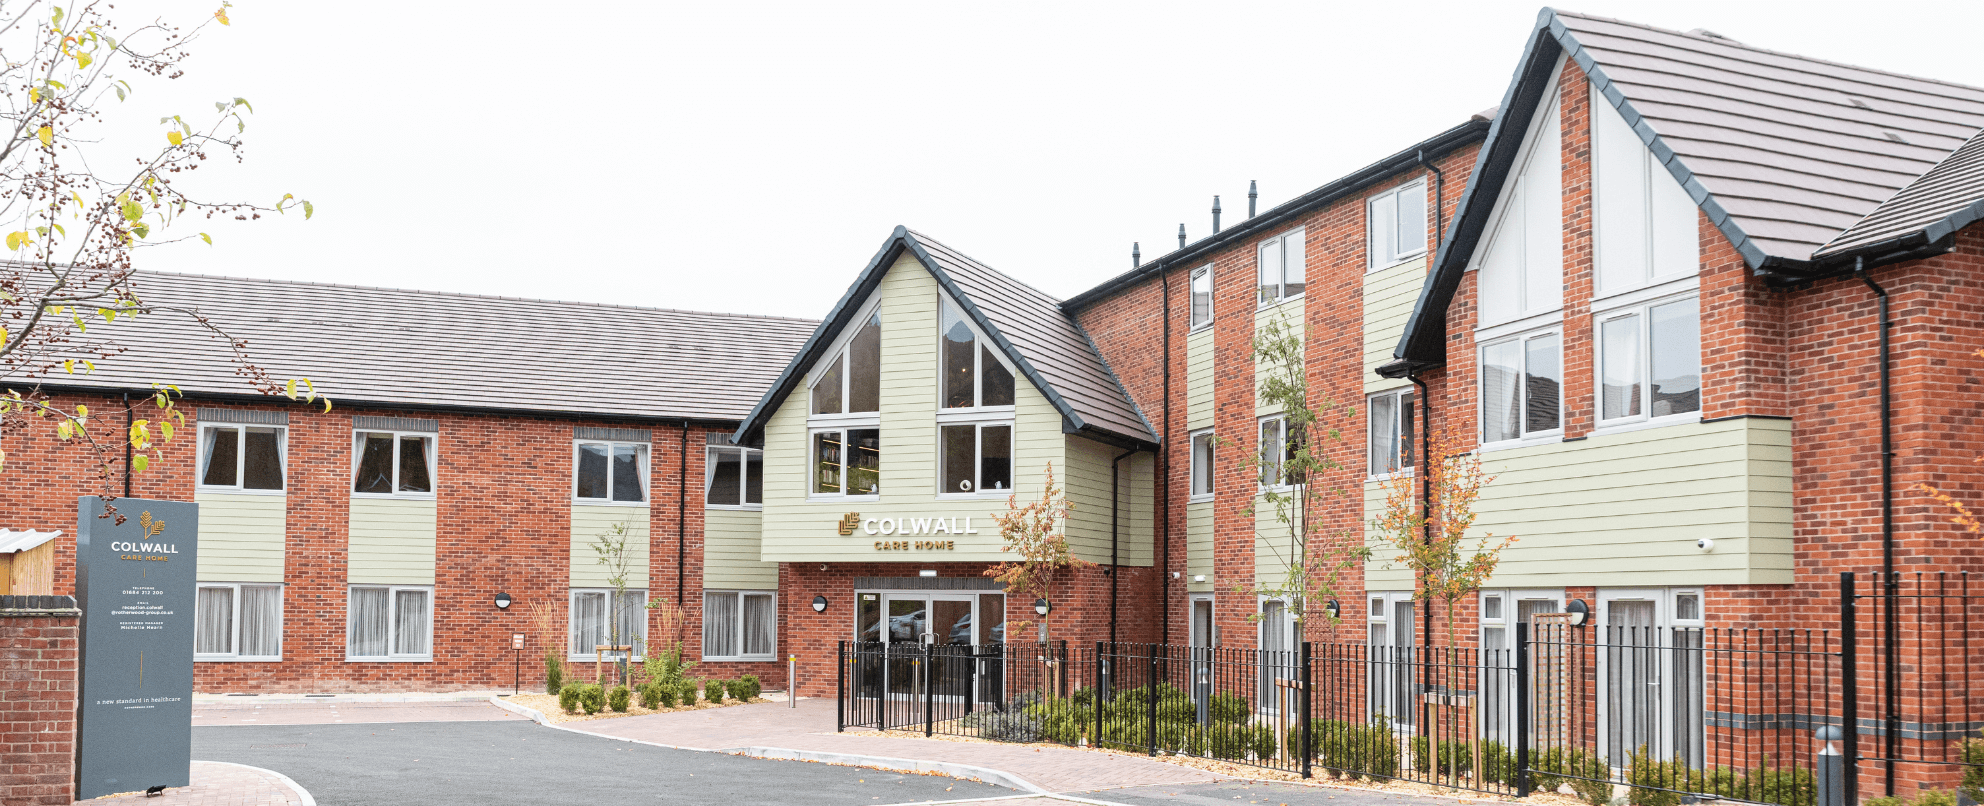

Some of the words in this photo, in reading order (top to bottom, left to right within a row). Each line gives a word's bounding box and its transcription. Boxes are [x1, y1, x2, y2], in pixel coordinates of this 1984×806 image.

[864, 516, 978, 536] COLWALL
[111, 541, 178, 554] COLWALL
[874, 540, 909, 550] CARE
[914, 540, 954, 550] HOME
